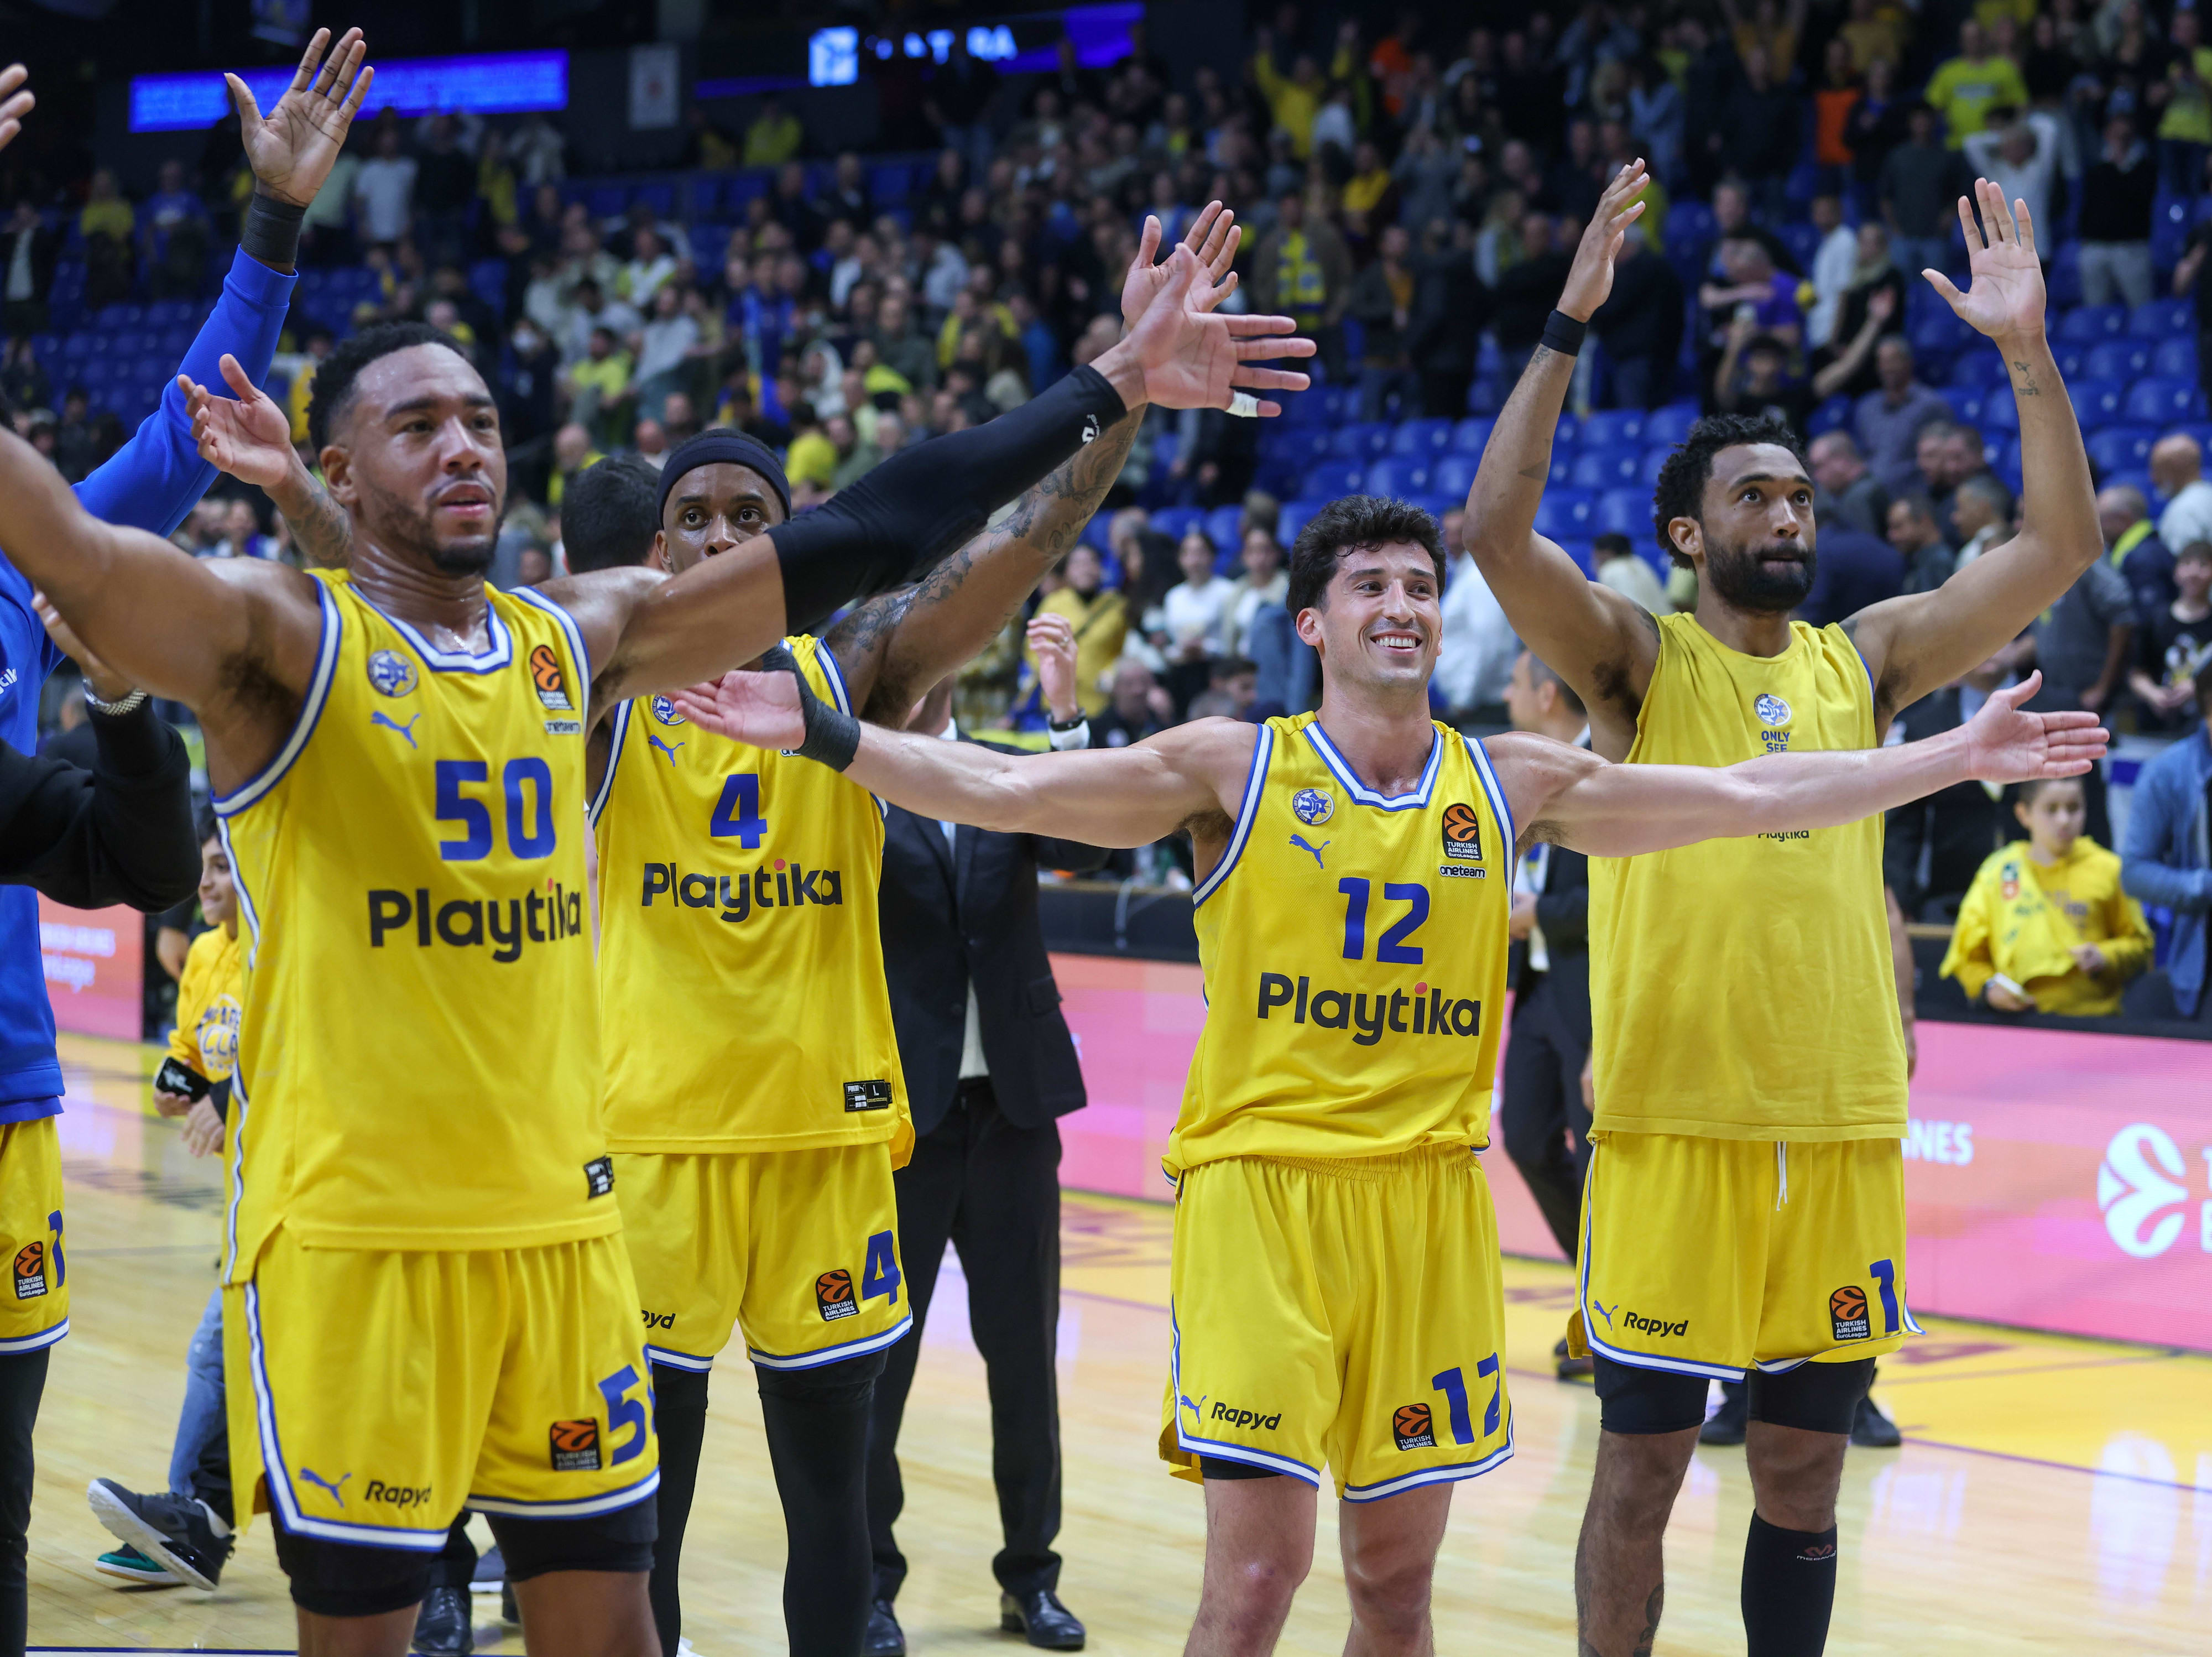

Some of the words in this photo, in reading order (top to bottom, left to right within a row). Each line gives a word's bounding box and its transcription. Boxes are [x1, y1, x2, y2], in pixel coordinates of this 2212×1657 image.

[1761, 731, 1790, 742] ONLY
[1766, 743, 1787, 753] SEE
[436, 757, 556, 861] 50
[710, 774, 768, 849] 4
[1440, 866, 1485, 878] oneteam
[641, 858, 843, 923] Playtika
[368, 878, 581, 963] Playtika
[1338, 877, 1430, 965] 12
[1257, 972, 1481, 1046] Playtika
[873, 1085, 880, 1096] L
[861, 1230, 901, 1306] 4
[18, 1275, 43, 1285] TURKISH
[19, 1281, 44, 1292] AIRLINES
[19, 1288, 45, 1298] EuroLeague
[1870, 1258, 1900, 1333] 1
[823, 1300, 853, 1311] TURKISH
[825, 1305, 855, 1317] AIRLINES
[826, 1311, 857, 1320] EuroLeague
[1624, 1311, 1689, 1338] Rapyd
[1835, 1319, 1866, 1328] TURKISH
[1432, 1352, 1501, 1445] 12
[1211, 1401, 1282, 1431] Rapyd
[1399, 1435, 1431, 1445] TURKISH
[1402, 1440, 1433, 1450] AIRLINES
